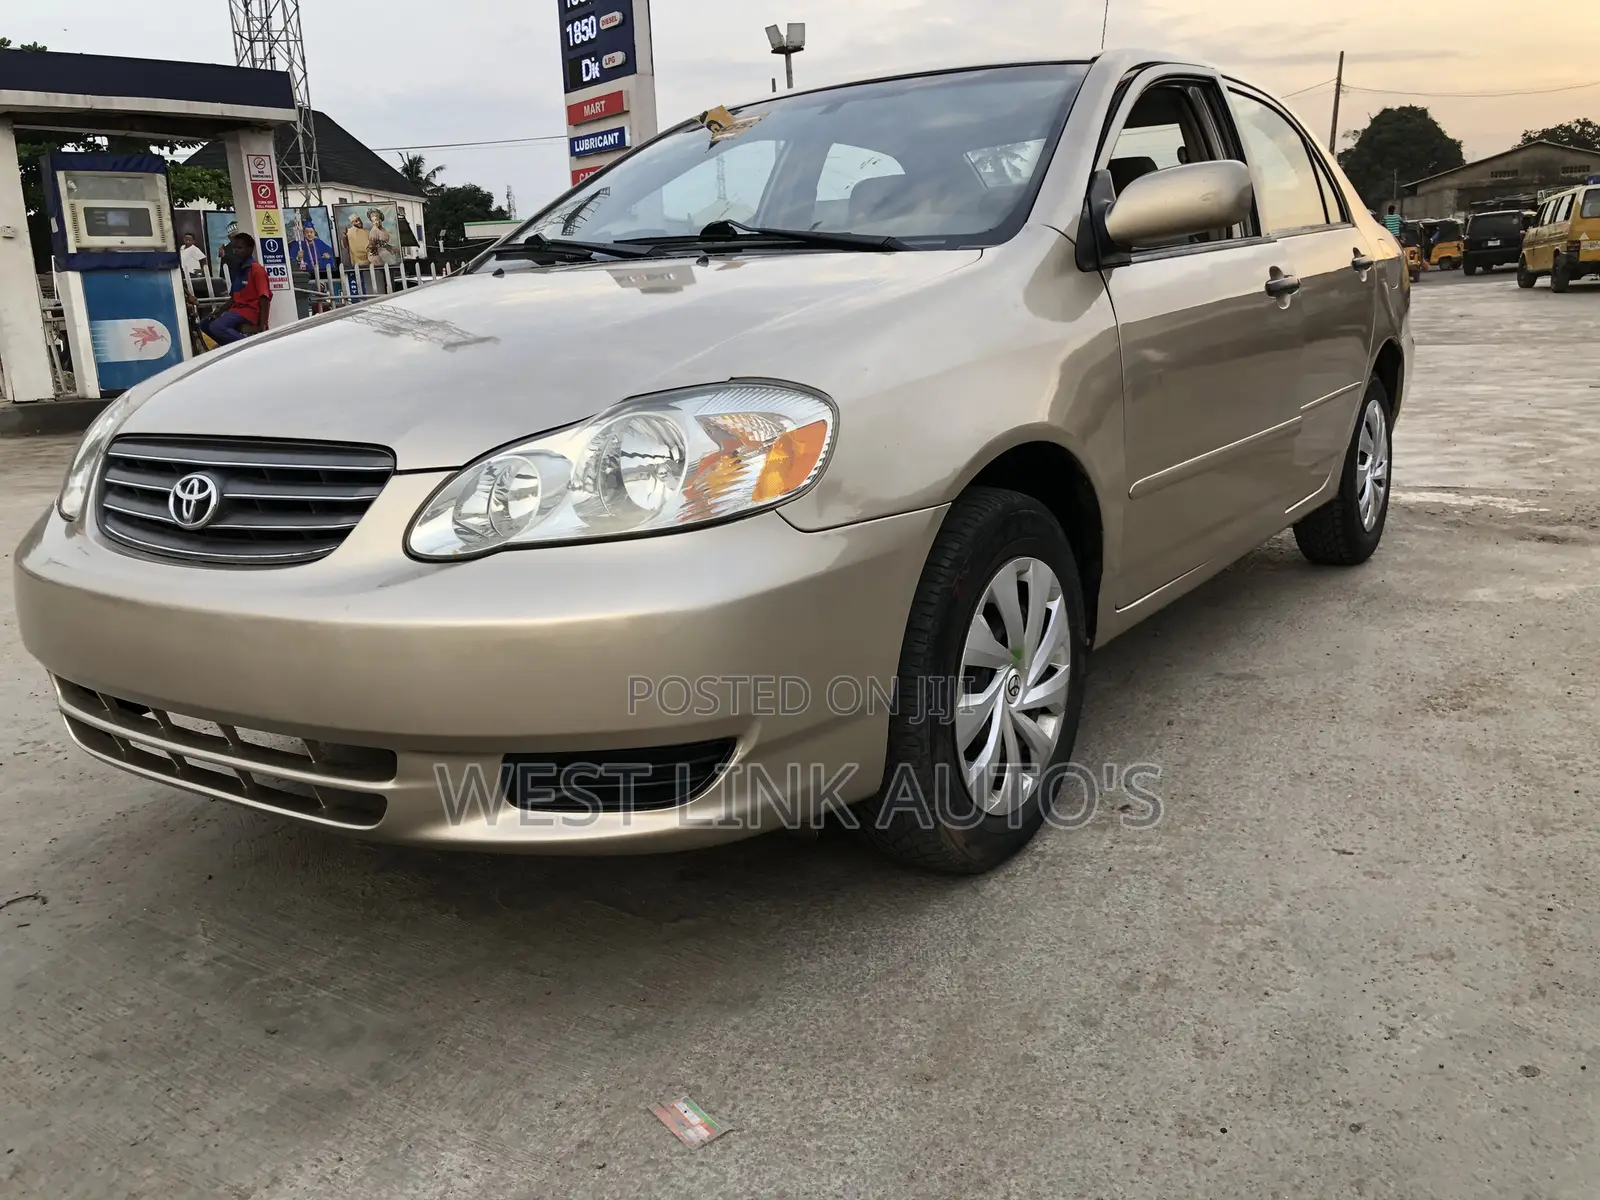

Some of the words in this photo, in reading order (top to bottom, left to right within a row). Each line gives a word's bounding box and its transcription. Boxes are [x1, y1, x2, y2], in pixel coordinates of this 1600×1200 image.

[601, 15, 618, 27] DIESEL
[566, 15, 597, 47] 1850
[604, 56, 616, 66] LPG
[583, 100, 606, 117] MART
[574, 131, 620, 152] LUBRICANT
[266, 267, 286, 276] POS
